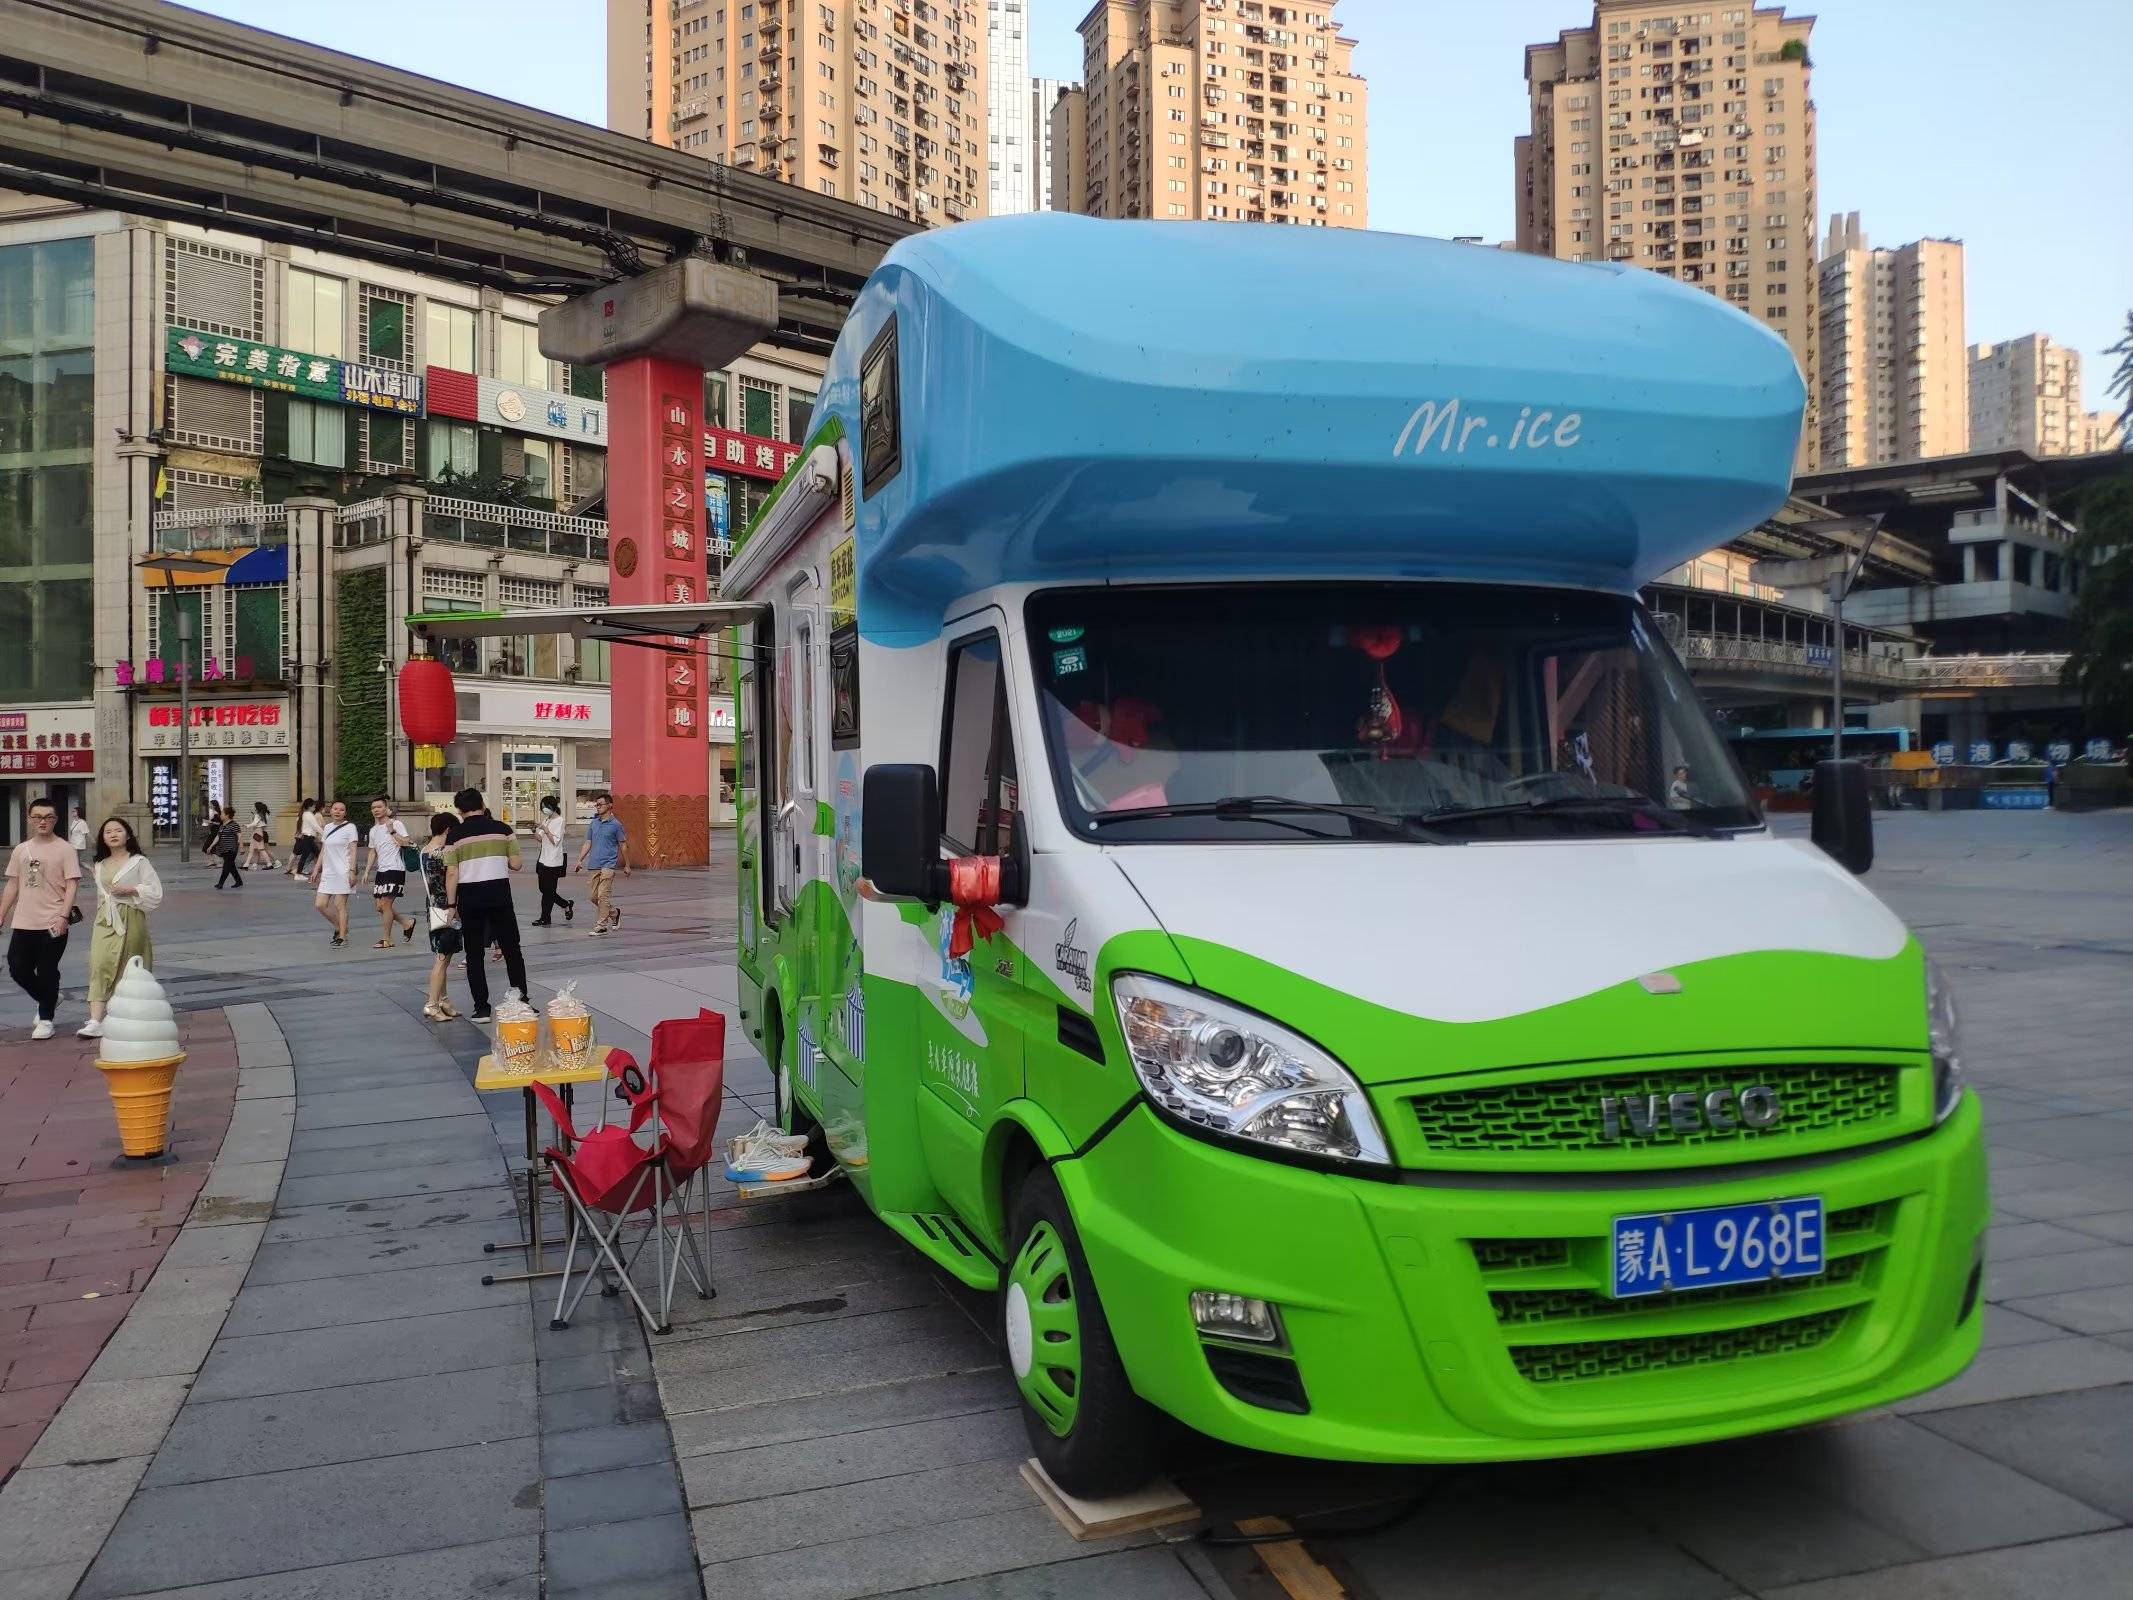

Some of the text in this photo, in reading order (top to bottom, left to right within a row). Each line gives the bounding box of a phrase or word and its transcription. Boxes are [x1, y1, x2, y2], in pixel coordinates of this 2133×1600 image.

[345, 364, 421, 401] 山木培训
[670, 406, 690, 551] 山水之城
[1059, 661, 1084, 675] 2021
[534, 702, 592, 721] 好利来
[1600, 1086, 1780, 1139] IVECO
